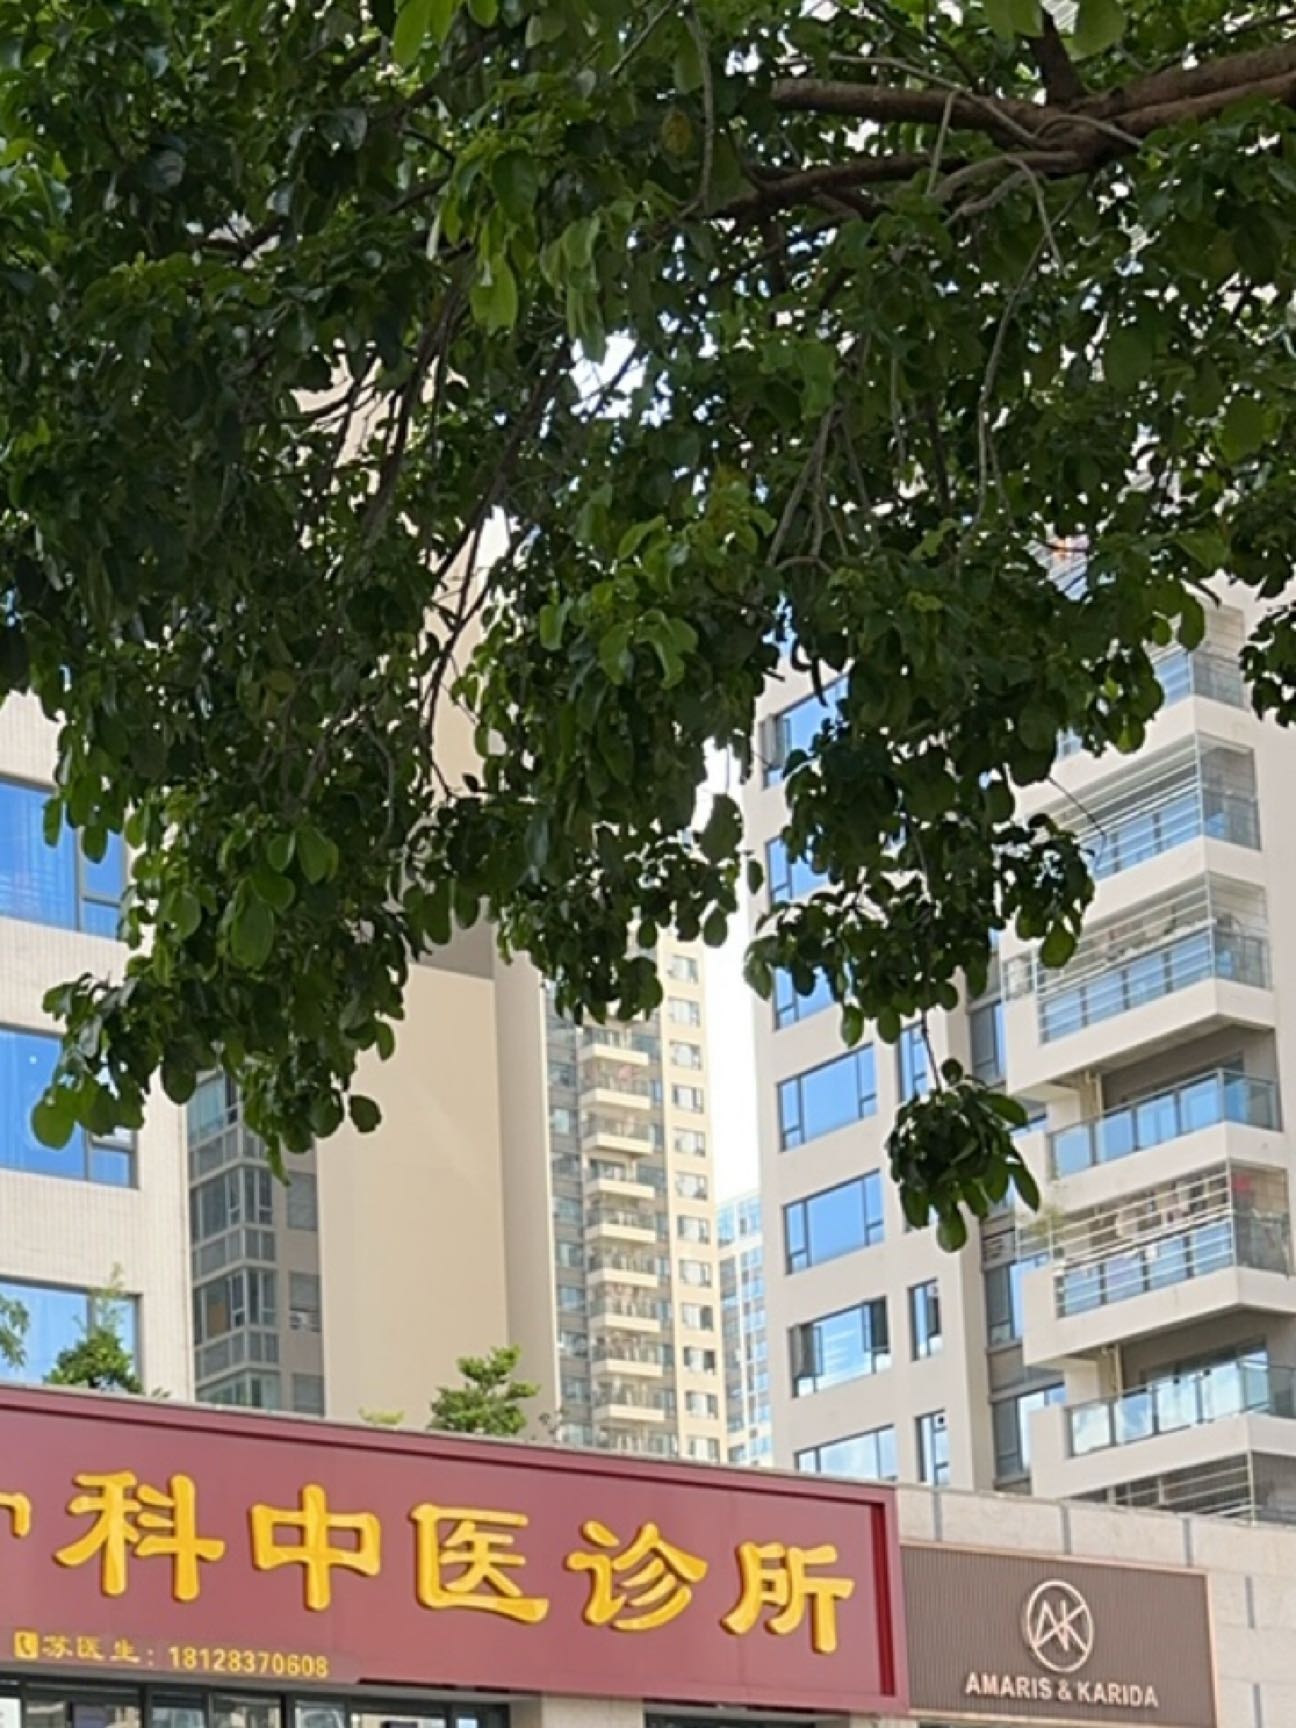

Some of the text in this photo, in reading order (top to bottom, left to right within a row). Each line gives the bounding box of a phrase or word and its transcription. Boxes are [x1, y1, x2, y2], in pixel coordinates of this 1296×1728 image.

[965, 1671, 1159, 1709] AMARIS & KARIDA
